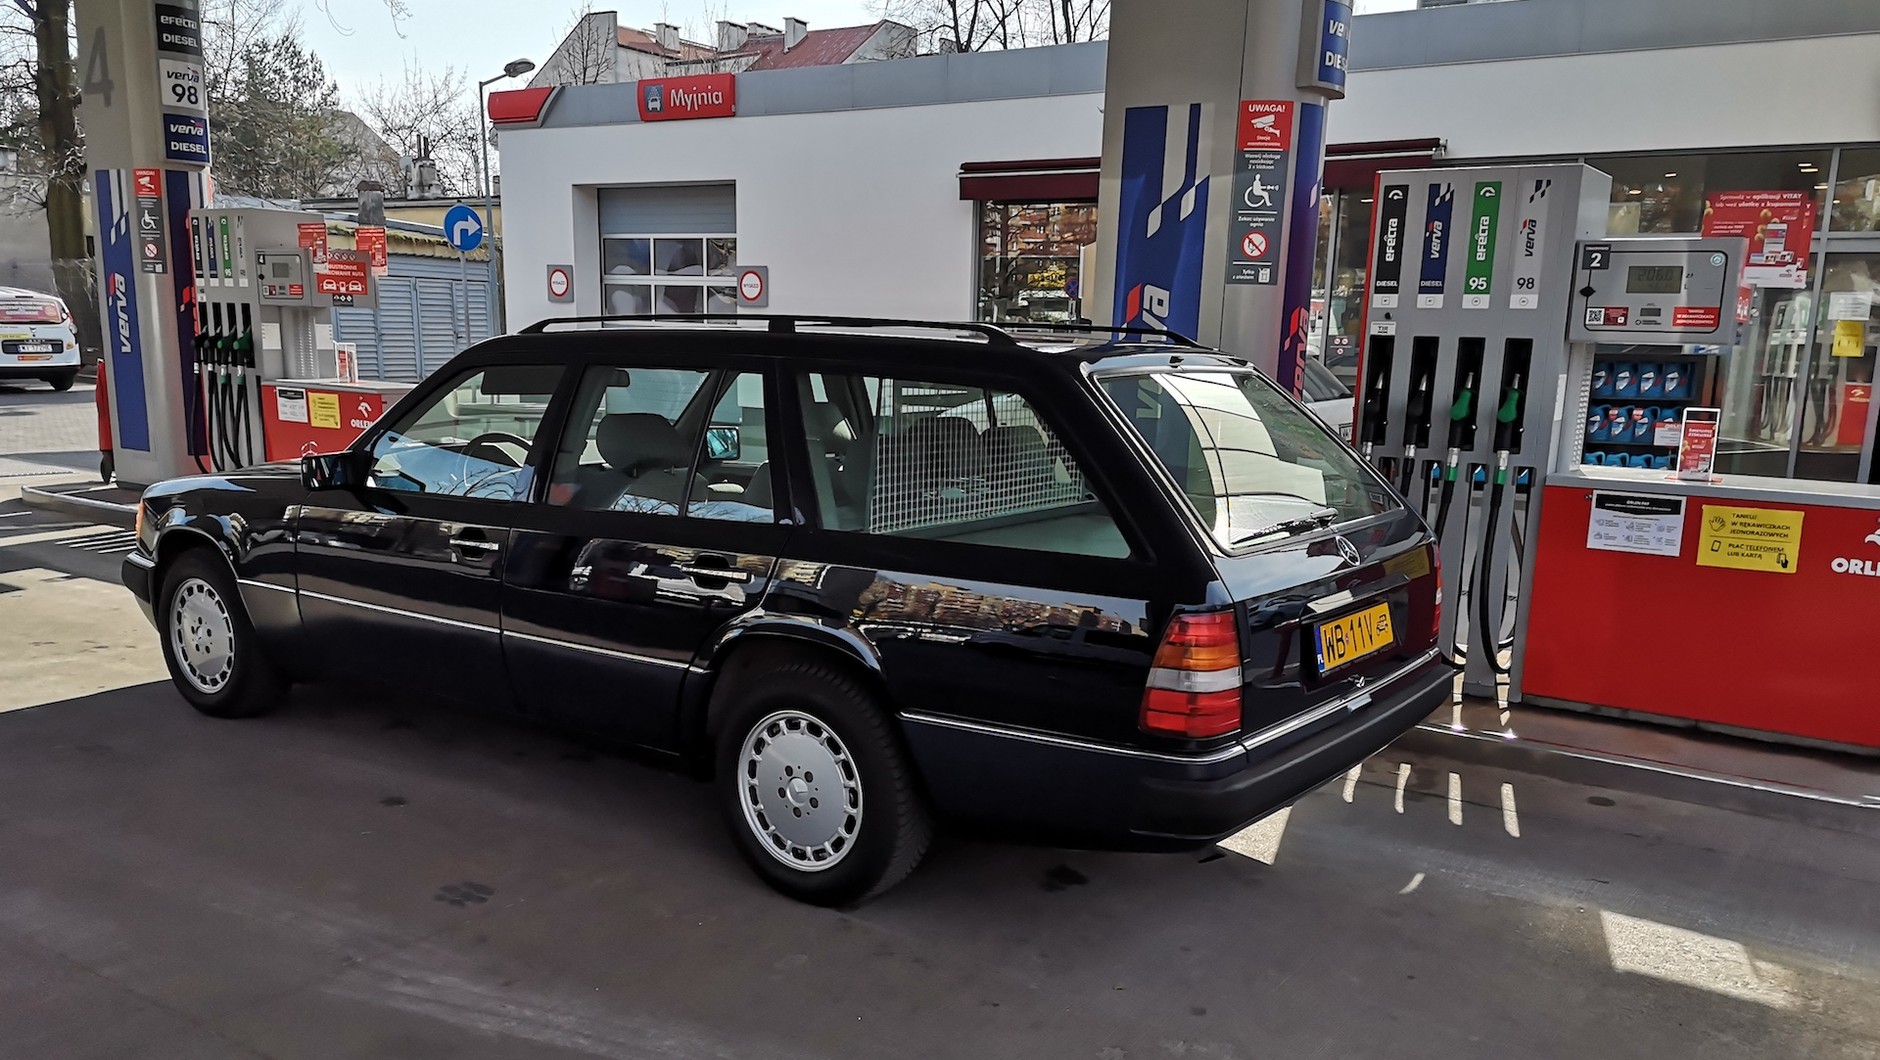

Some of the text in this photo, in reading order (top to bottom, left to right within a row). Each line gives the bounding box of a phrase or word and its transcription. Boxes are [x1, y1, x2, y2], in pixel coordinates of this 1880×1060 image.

[162, 33, 199, 48] DIESEL
[84, 26, 115, 108] 4
[166, 70, 200, 83] verva
[171, 83, 199, 105] 98
[670, 85, 723, 111] Myjnia
[1248, 104, 1286, 113] UWAGA!
[170, 123, 204, 136] verva
[170, 141, 207, 155] DIESEL
[1384, 218, 1398, 262] efecta
[1430, 220, 1443, 259] verva
[1476, 216, 1490, 261] efecta
[1524, 219, 1537, 257] verva
[1590, 252, 1602, 267] 2
[1468, 277, 1488, 291] 95
[1516, 277, 1535, 290] 98
[113, 272, 132, 353] verva
[1745, 544, 1784, 553] TELEFONEM
[1831, 557, 1880, 577] ORL
[1323, 624, 1346, 664] WB
[1349, 612, 1374, 652] 11V
